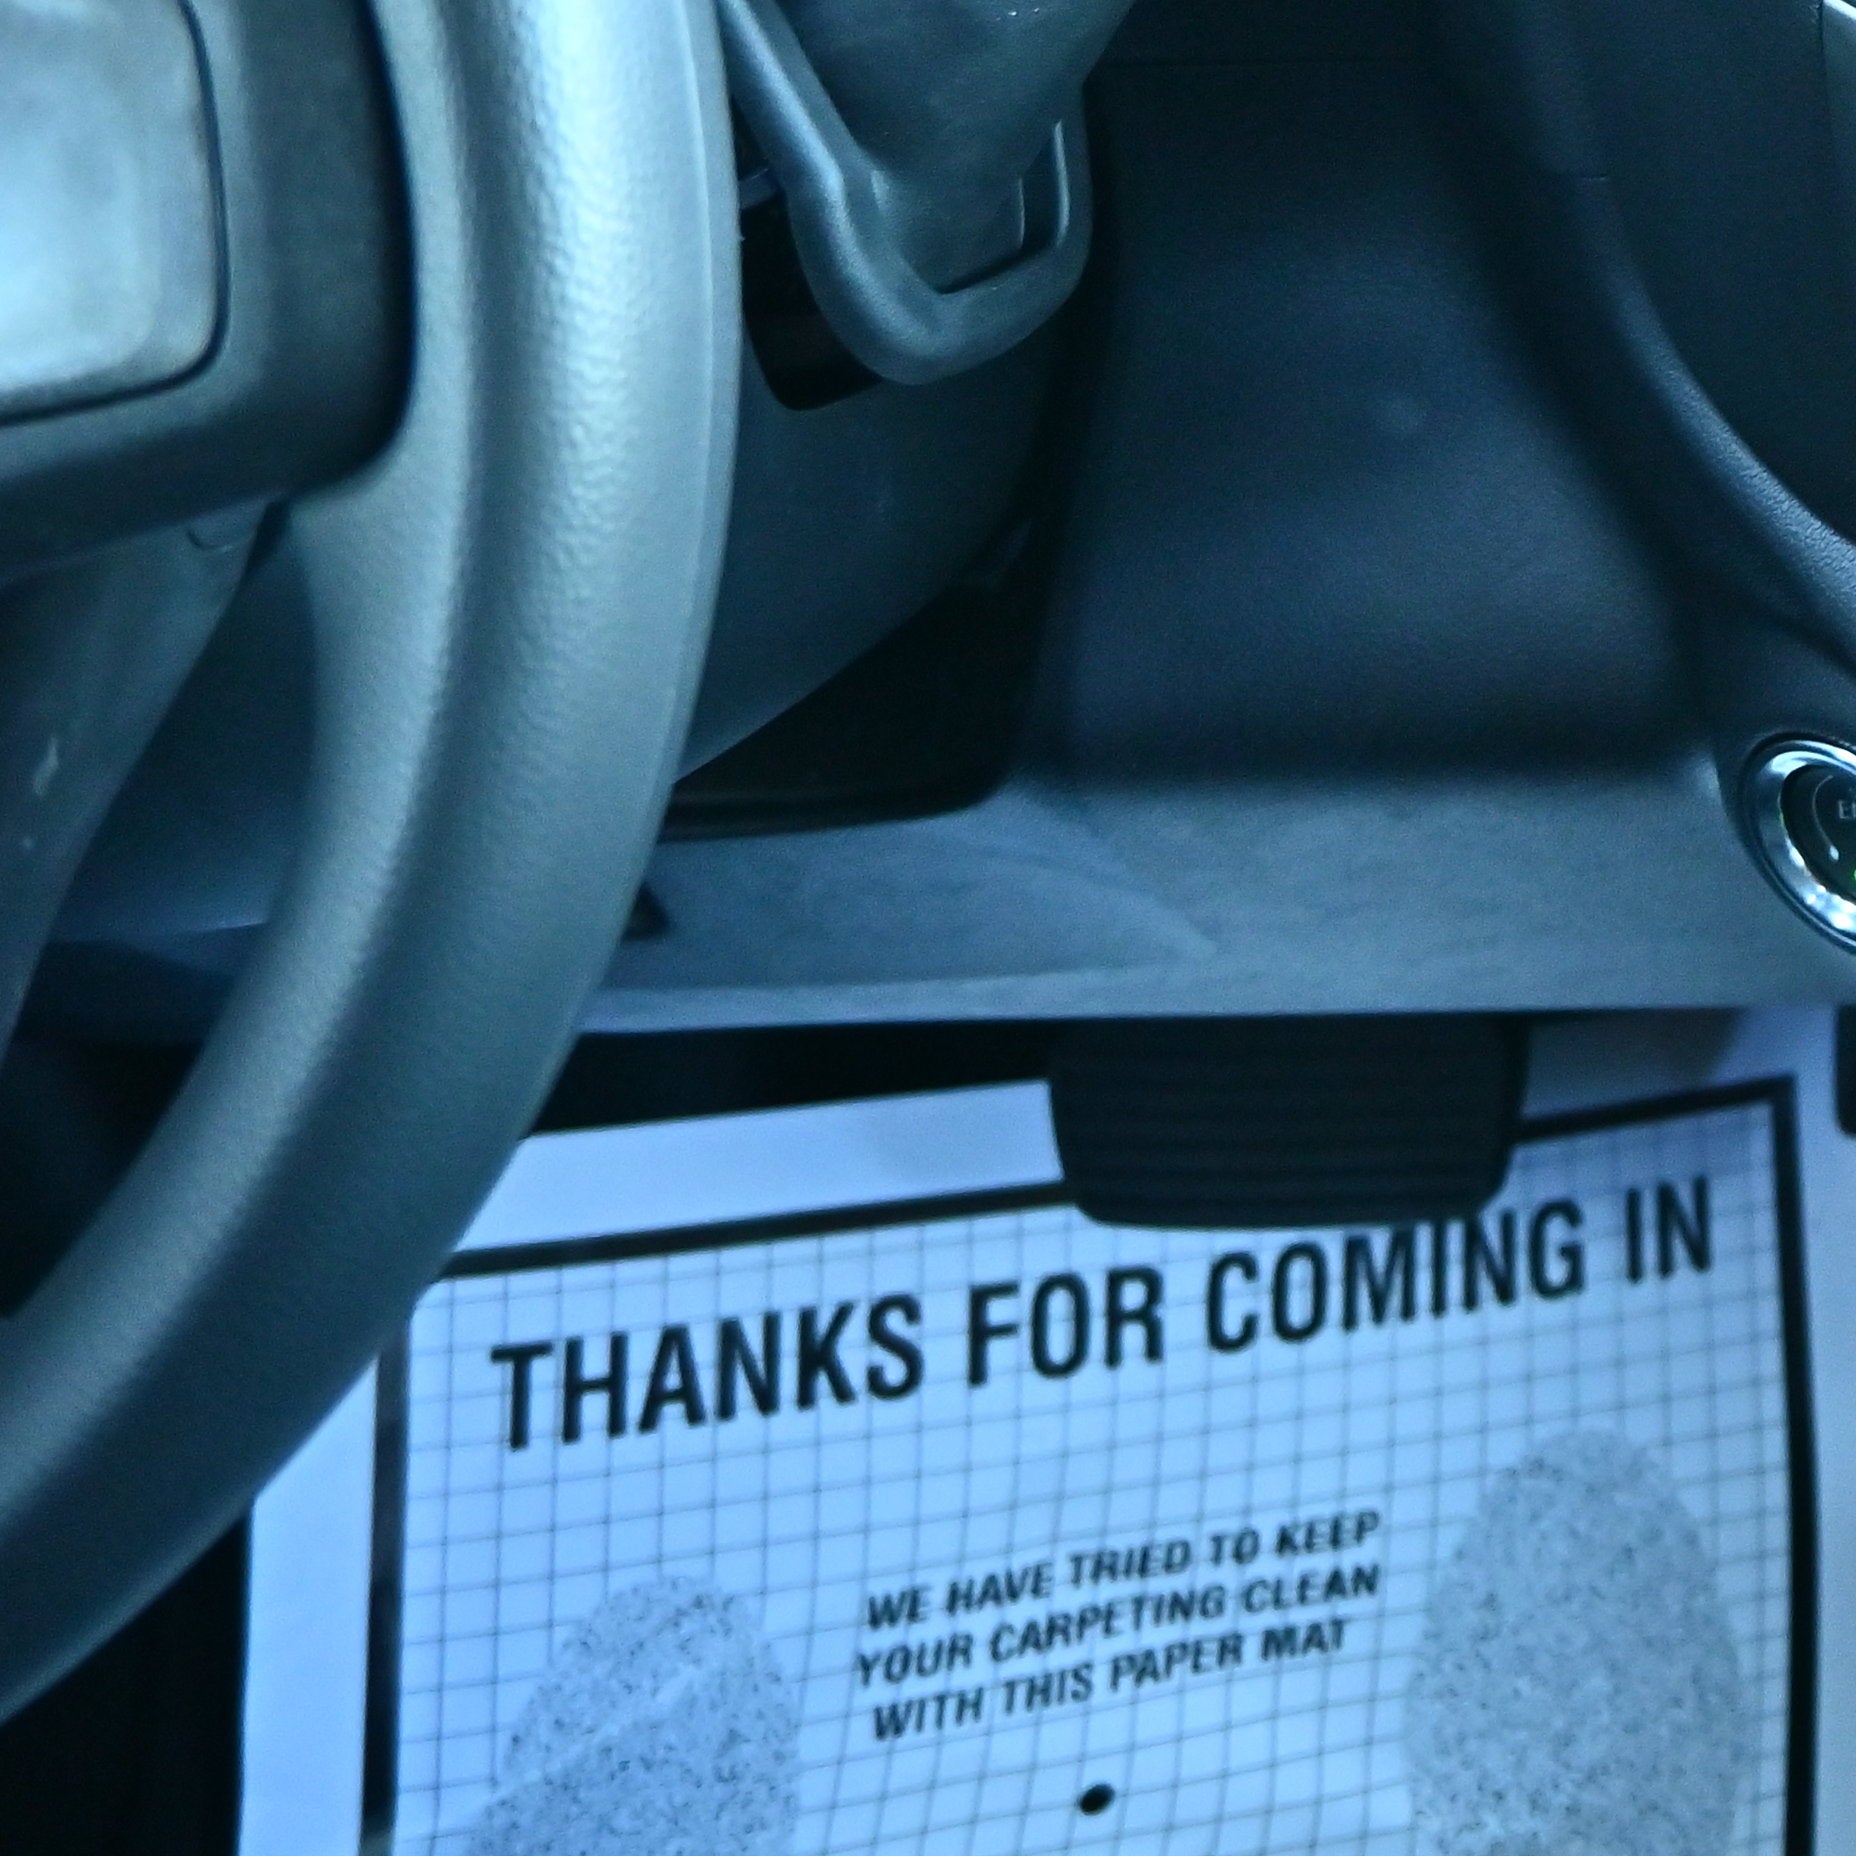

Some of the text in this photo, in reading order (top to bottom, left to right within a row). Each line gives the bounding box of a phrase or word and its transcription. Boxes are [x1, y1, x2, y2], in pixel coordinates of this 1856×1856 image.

[491, 1174, 1712, 1451] THANKS FOR COMING IN
[856, 1563, 1380, 1687] YOUR CARPETING CLEAN
[867, 1510, 1380, 1630] WE HAVE TRIED TO KEEP
[873, 1618, 1348, 1742] WITH THIS PAPER MAT
